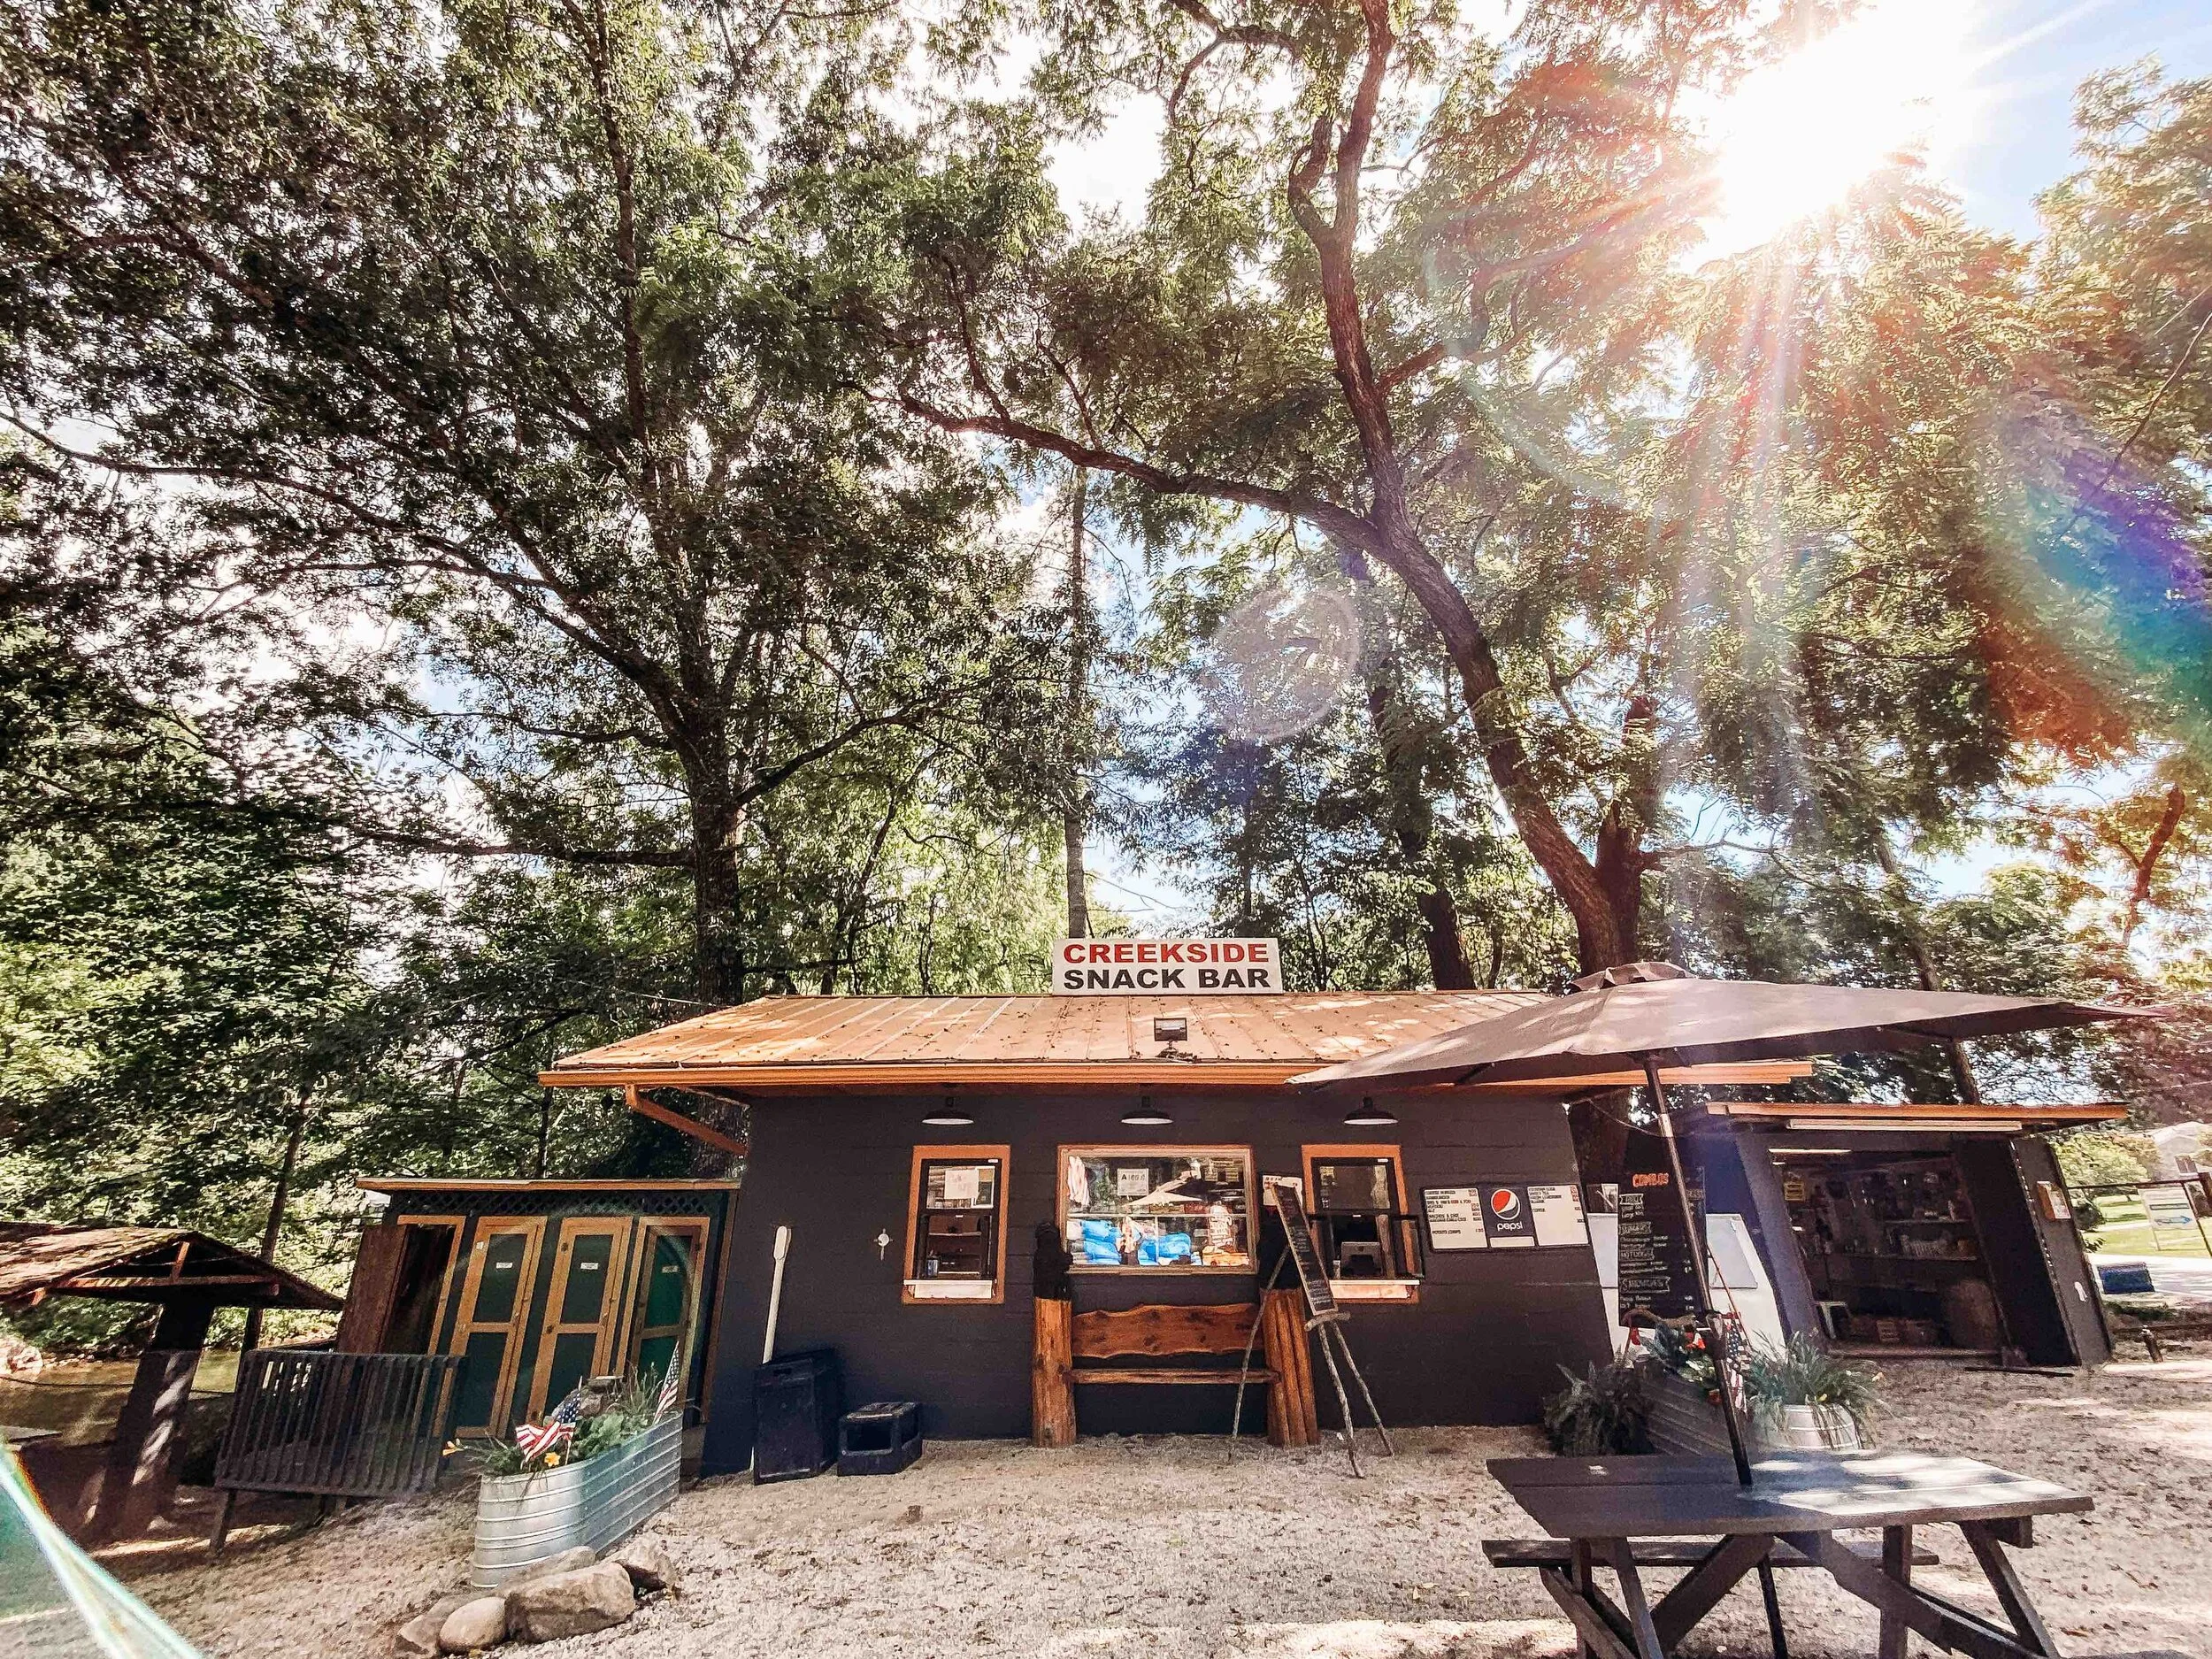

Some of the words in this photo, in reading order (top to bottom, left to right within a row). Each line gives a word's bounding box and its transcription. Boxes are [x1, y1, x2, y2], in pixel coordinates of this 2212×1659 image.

[1063, 943, 1269, 964] CREEKSIDE
[1063, 968, 1186, 990] SNACK
[1198, 968, 1271, 988] BAR
[1496, 1221, 1524, 1232] pepsi
